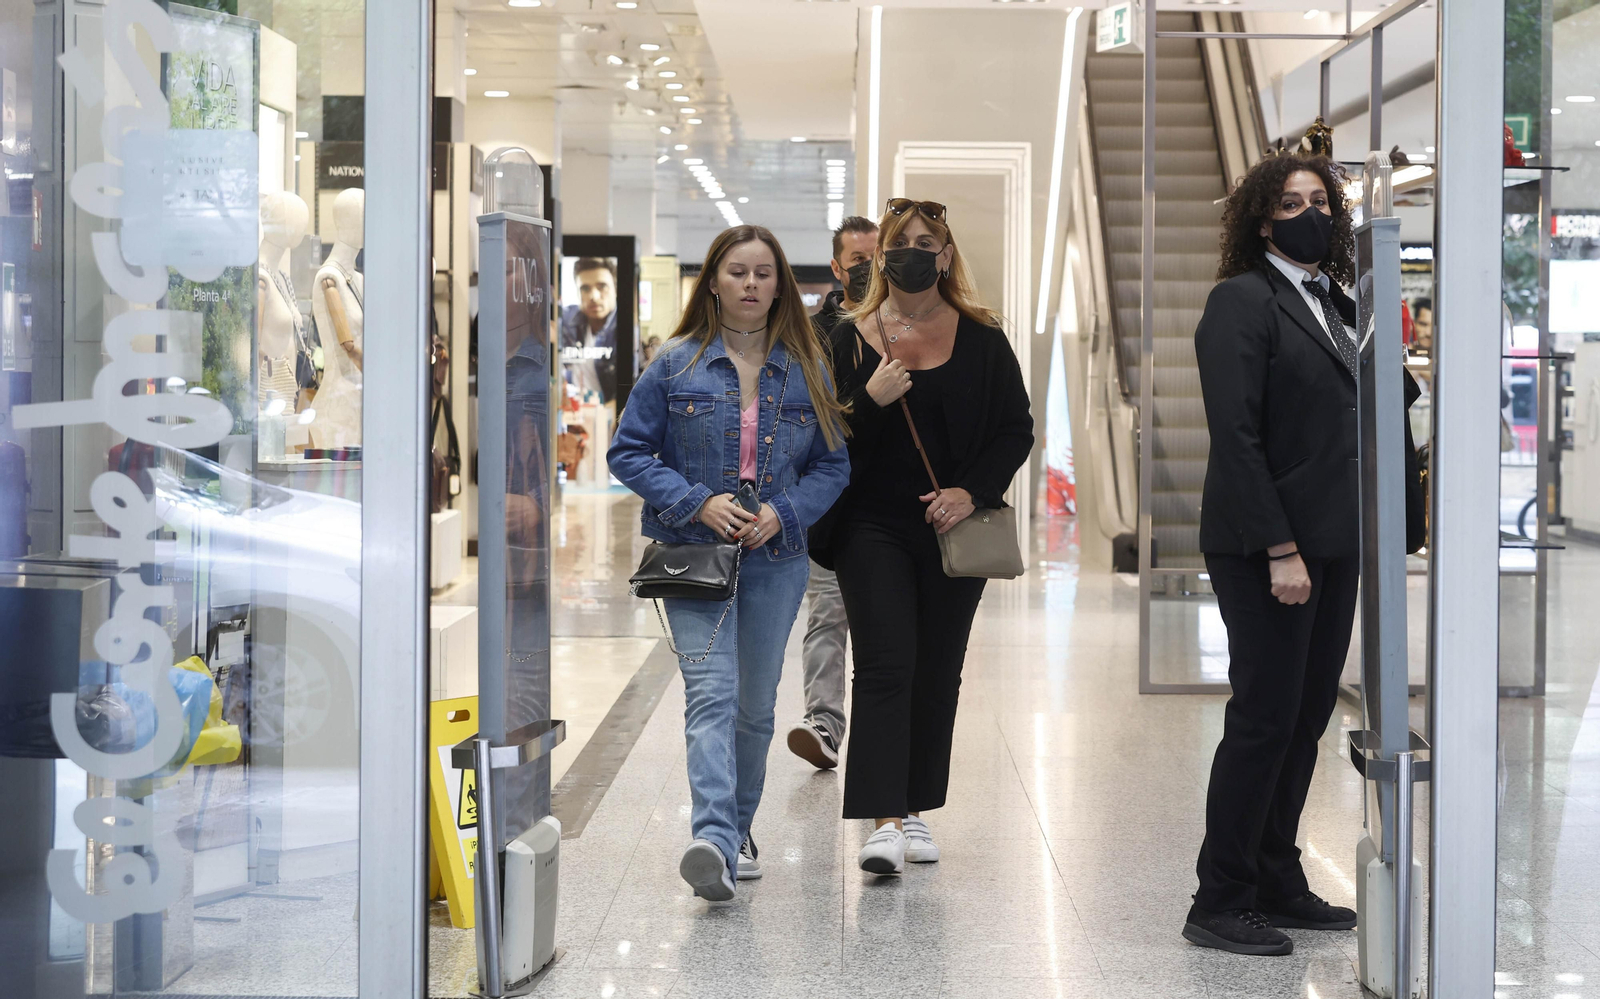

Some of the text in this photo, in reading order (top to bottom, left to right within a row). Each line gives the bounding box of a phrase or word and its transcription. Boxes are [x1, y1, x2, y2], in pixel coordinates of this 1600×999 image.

[190, 58, 238, 95] VIDA
[193, 287, 220, 302] Planta
[50, 467, 185, 779] Corte
[47, 795, 184, 923] El
